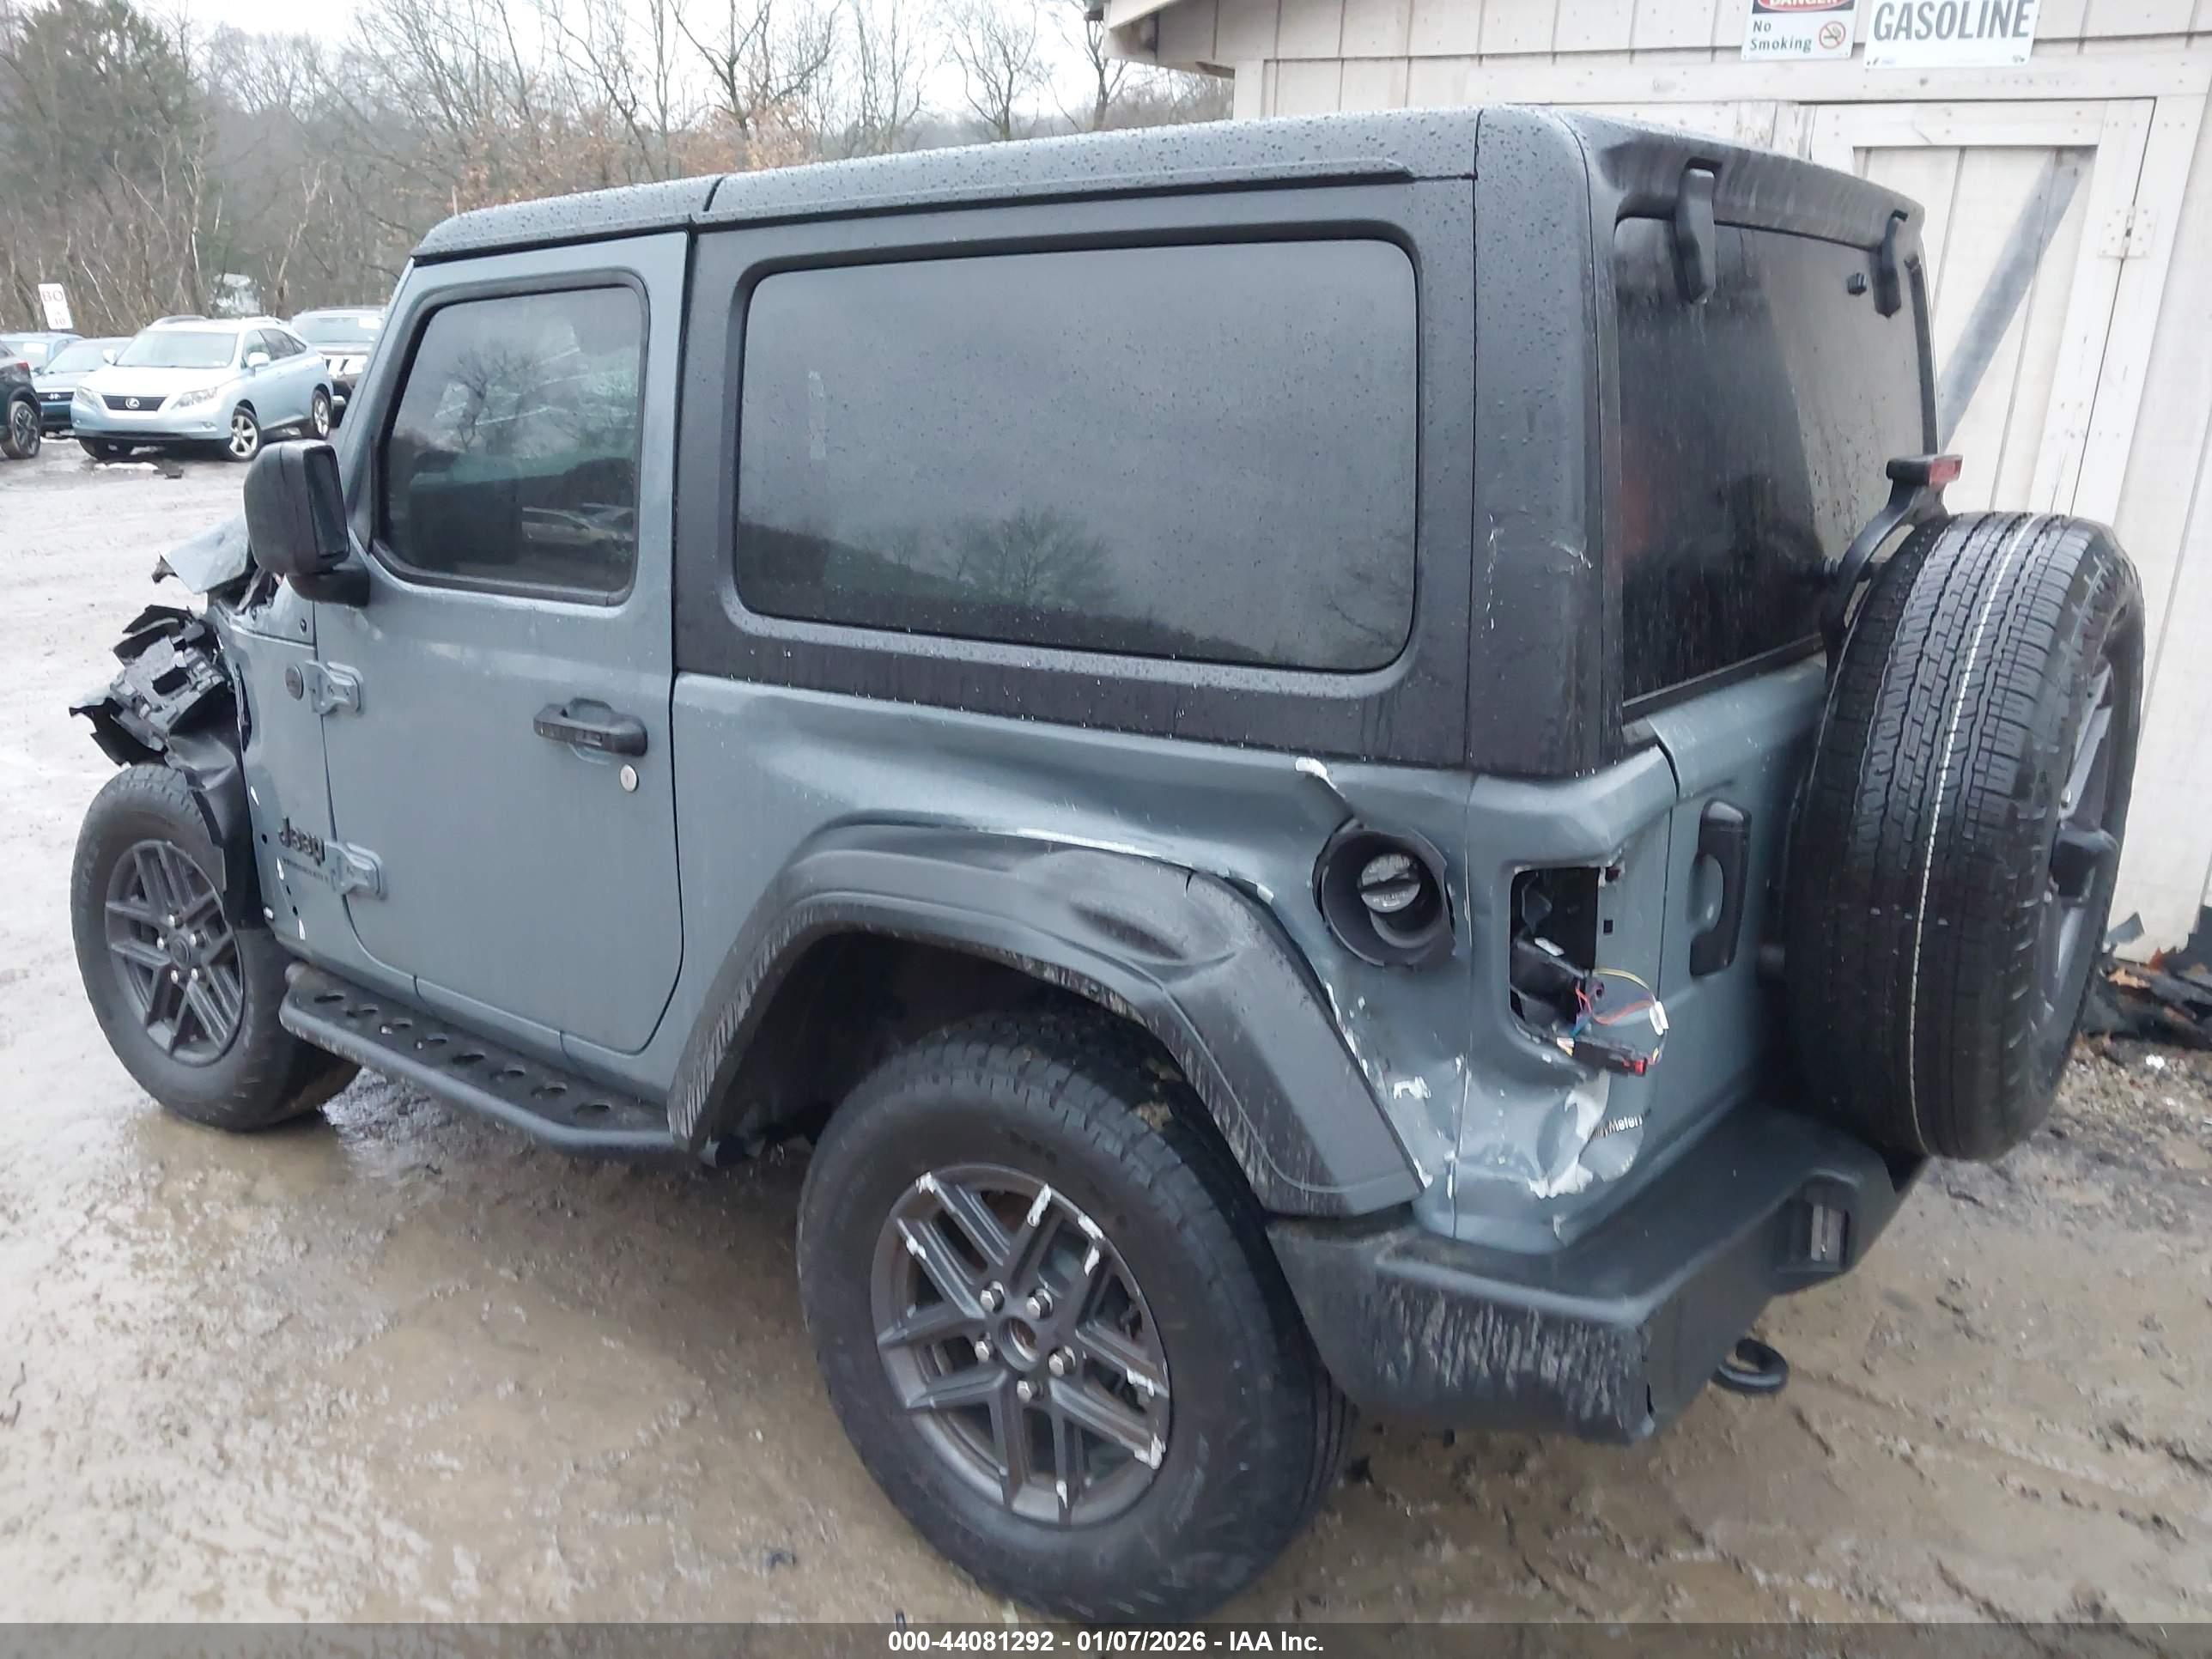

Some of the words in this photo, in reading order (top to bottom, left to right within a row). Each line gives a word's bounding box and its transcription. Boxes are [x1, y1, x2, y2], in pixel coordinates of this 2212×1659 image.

[1753, 20, 1771, 33] No
[1874, 0, 2035, 41] GASOLINE
[1750, 34, 1812, 53] Smoking
[278, 817, 325, 866] Jeep
